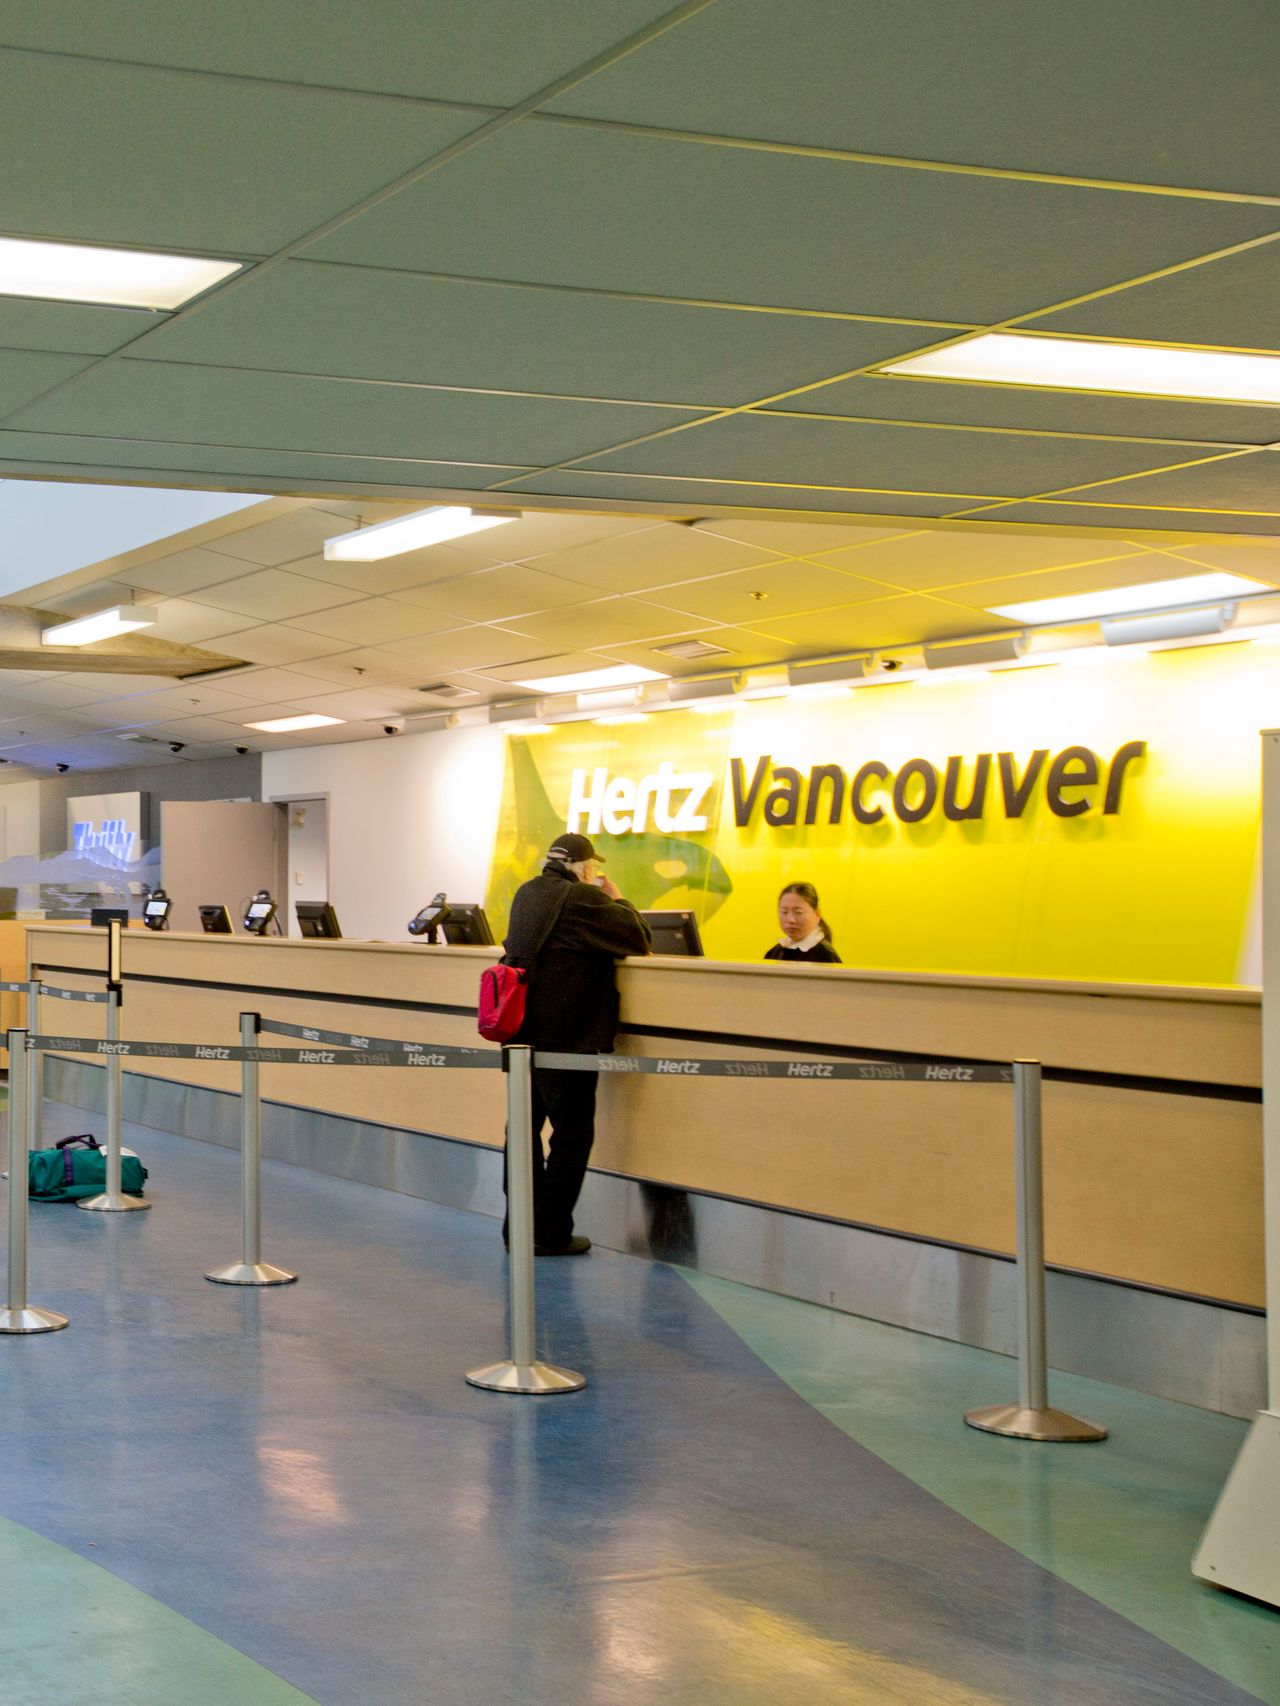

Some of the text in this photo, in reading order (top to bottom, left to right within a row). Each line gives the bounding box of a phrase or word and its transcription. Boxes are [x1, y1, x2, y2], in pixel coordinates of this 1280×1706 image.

[565, 740, 1147, 834] Hertz Vancouver
[302, 1028, 320, 1041] Hertz
[97, 1041, 131, 1055] Hertz
[351, 1035, 369, 1049] Hertz
[195, 1046, 231, 1060] Hertz
[298, 1050, 335, 1064] Hertz
[407, 1053, 446, 1067] Hertz
[656, 1060, 700, 1075] Hertz
[787, 1063, 834, 1077] Hertz
[925, 1065, 974, 1081] Hertz
